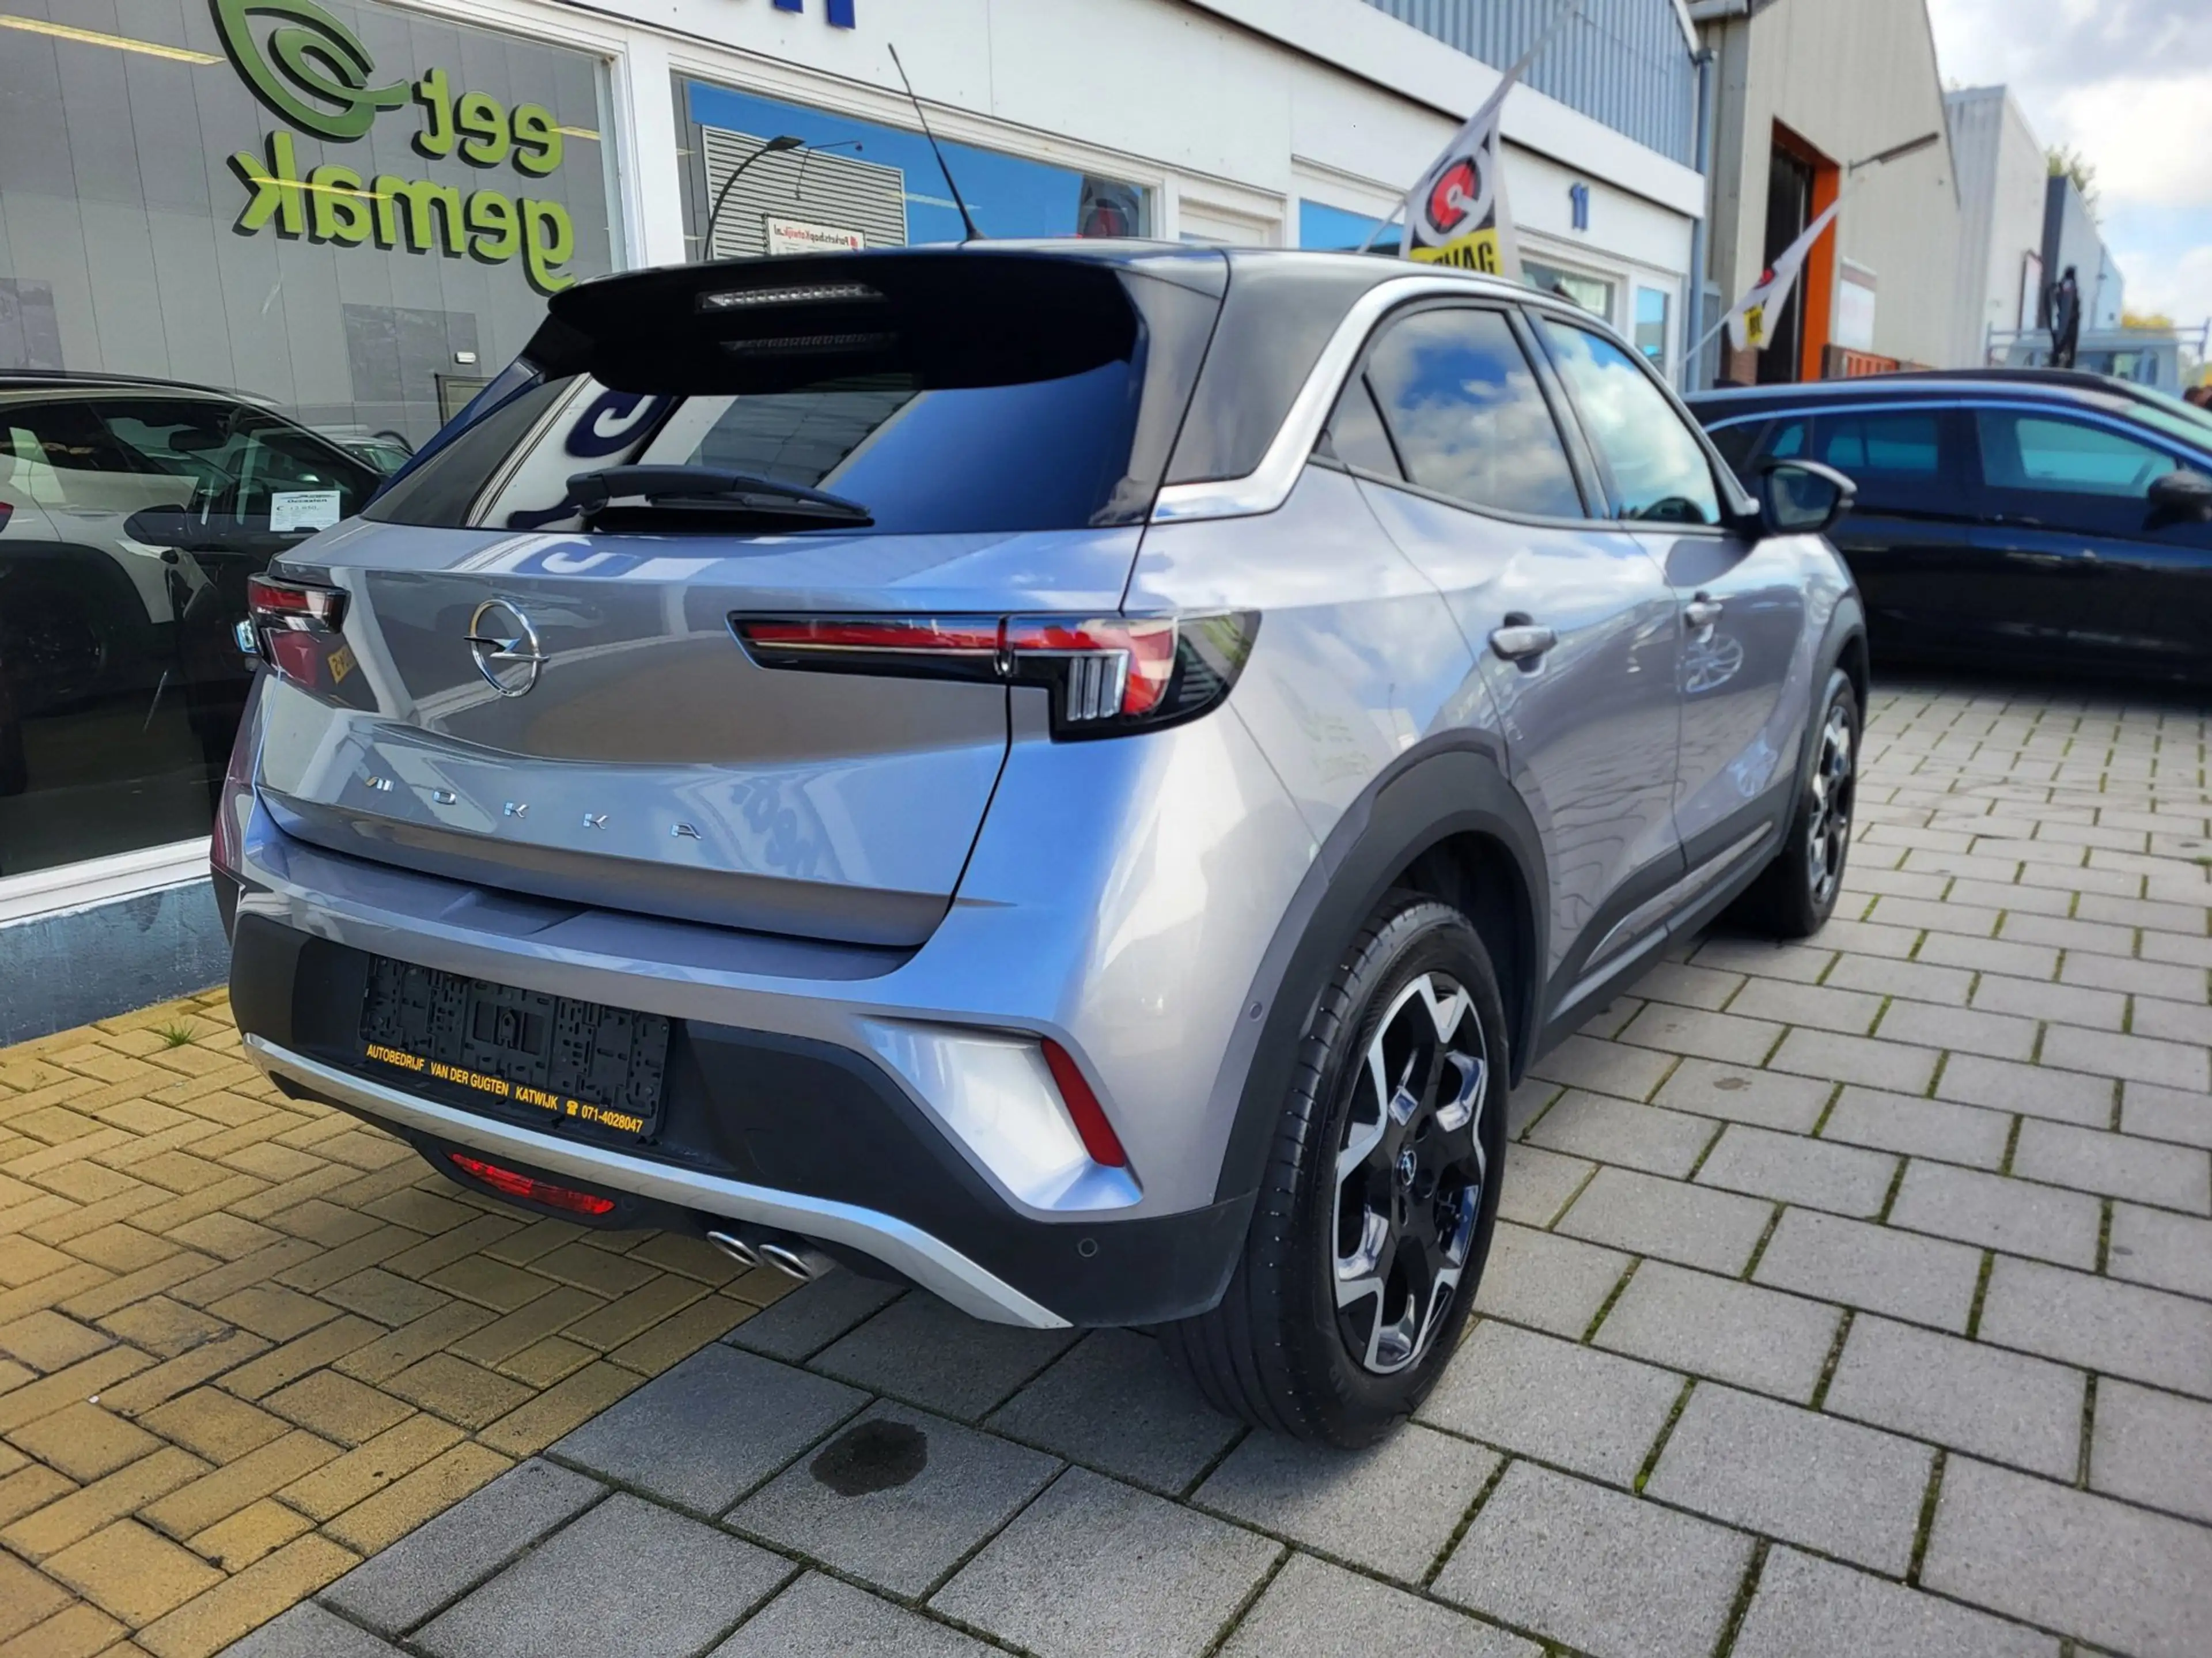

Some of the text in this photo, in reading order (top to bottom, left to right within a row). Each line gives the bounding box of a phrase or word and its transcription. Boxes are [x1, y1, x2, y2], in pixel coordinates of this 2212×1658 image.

[1569, 183, 1589, 232] 11
[1431, 240, 1496, 275] VAG
[364, 775, 702, 841] MOKKA
[366, 1044, 643, 1134] AUTOBEDRIJF VAN DER GUGTEN KATWIJK 071-4028047
